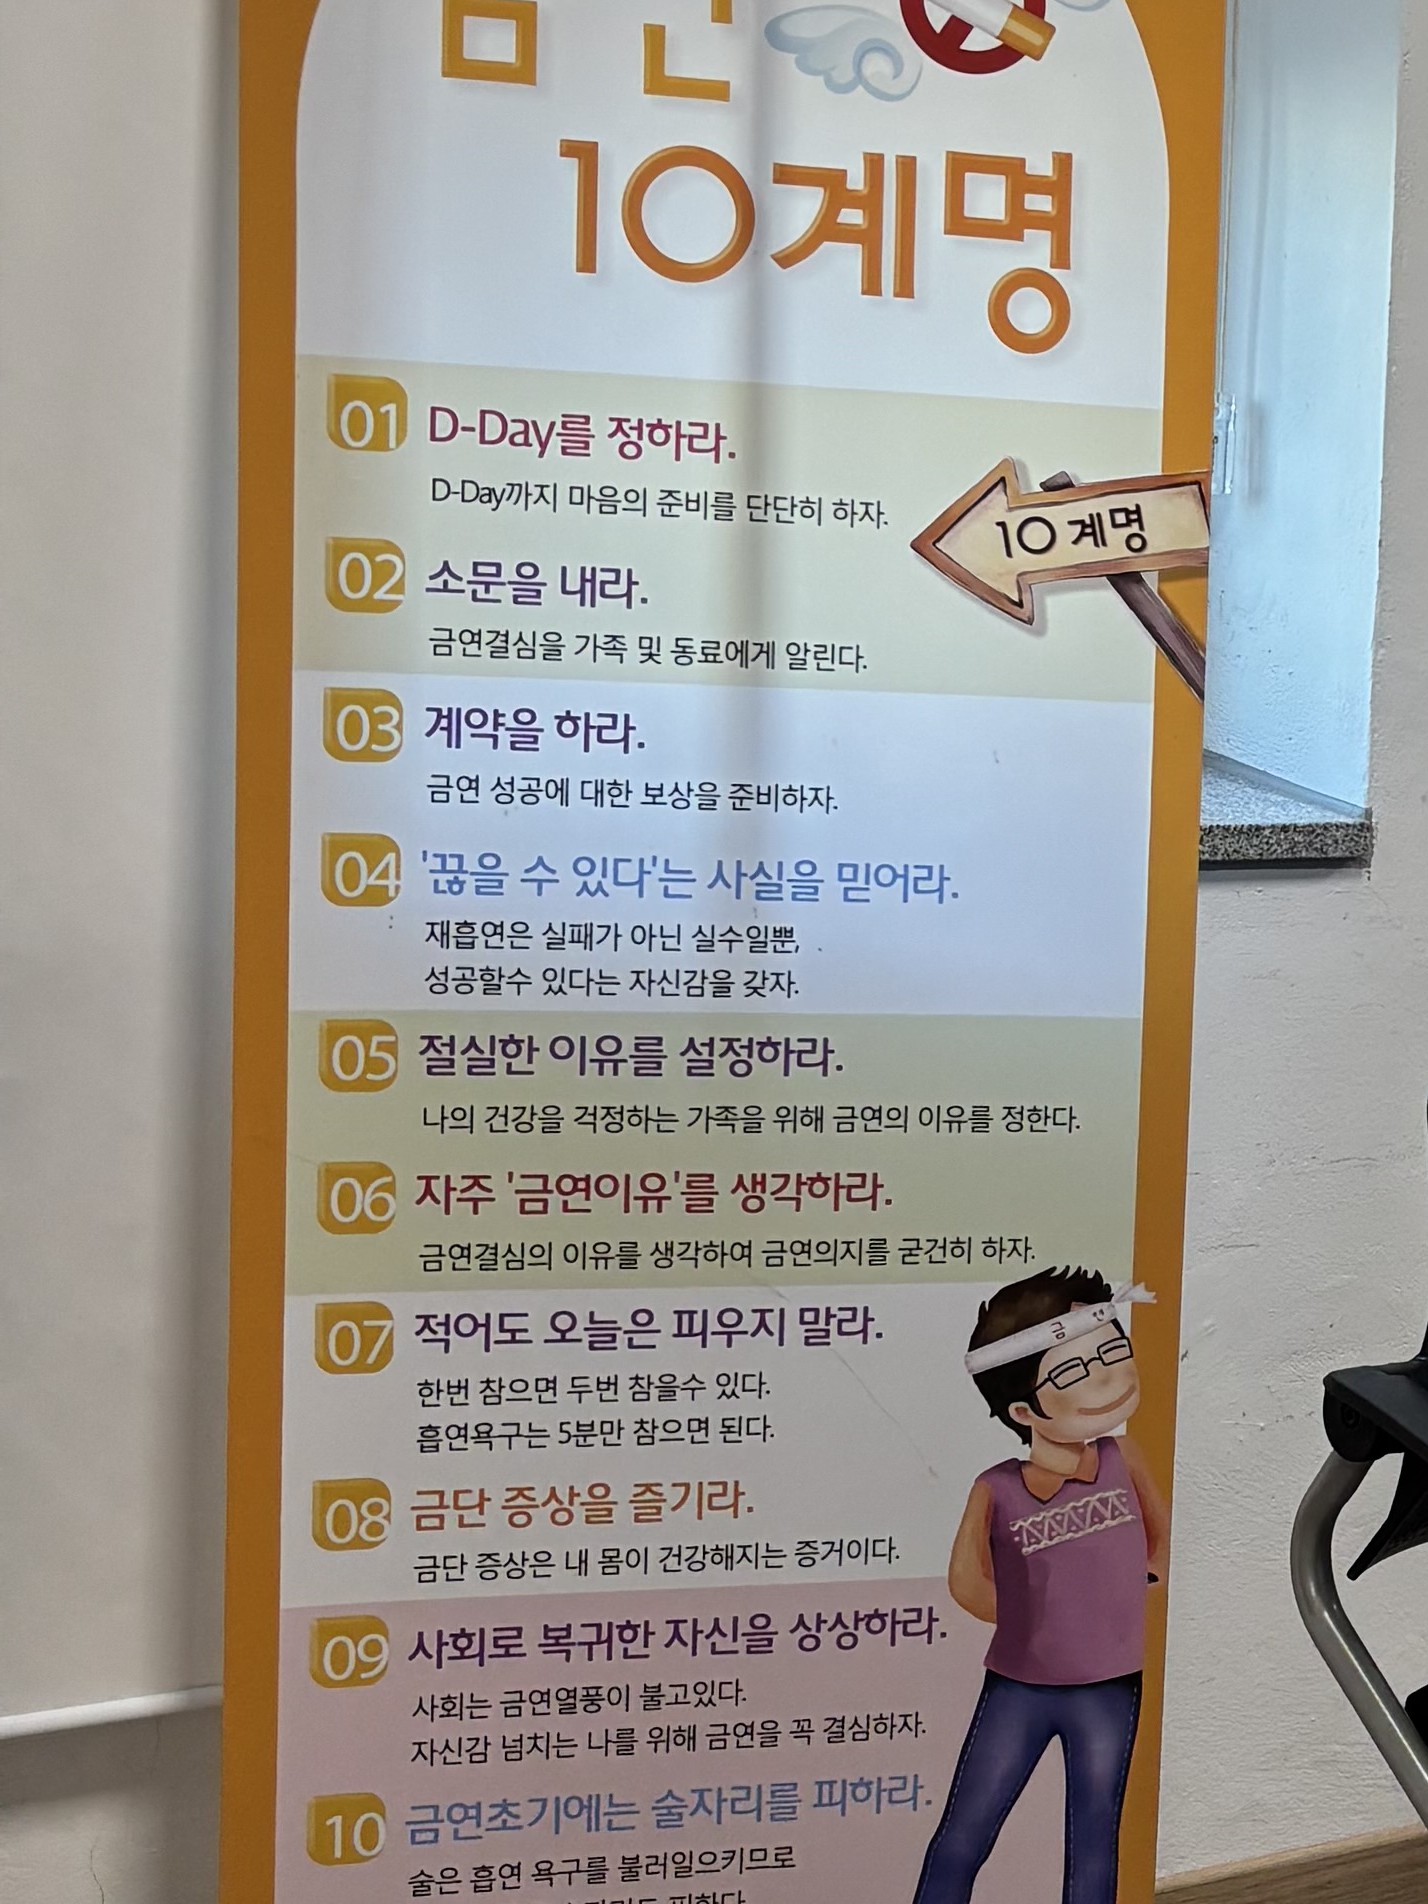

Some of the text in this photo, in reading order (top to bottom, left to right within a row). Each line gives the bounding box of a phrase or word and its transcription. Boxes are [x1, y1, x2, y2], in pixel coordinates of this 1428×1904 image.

[558, 137, 1074, 355] 10계명
[340, 400, 736, 464] 01 D-Day를 정하라.
[431, 477, 889, 530] D-Day까지 마음의 준비를 단단히 하자.
[338, 552, 648, 610] 02 소문을 내라.
[428, 627, 868, 674] 금연결심을 가족 및 동료에게 알린다.
[335, 703, 647, 755] 03 계약을 하라.
[426, 774, 839, 815] 금연 성공에 대한 보상을 준비하자.
[333, 850, 960, 905] 04 '끊을 수 있다'는 사실을 믿어라.
[424, 920, 801, 955] 재흡연은 실패가 아닌 실수일뿐,
[542, 968, 622, 997] 있다는
[629, 969, 736, 998] 자신감을
[743, 969, 800, 1000] 갖자.
[331, 1033, 845, 1082] 05 절실한 이유를 설정하라.
[422, 1104, 1082, 1135] 나의 건강을 걱정하는 가족을 위해 금연의 이유를 정한다.
[330, 1171, 894, 1224] 06 자주 '금연이유'를 생각하라.
[418, 1236, 1037, 1273] 금연결심의 이유를 생각하여 금연의지를 굳건히 하자.
[327, 1304, 884, 1366] 07 적어도 오늘은 피우지 말라.
[416, 1377, 470, 1408] 한번
[478, 1375, 559, 1407] 참으면
[567, 1373, 620, 1405] 두번
[715, 1370, 771, 1401] 있다.
[416, 1415, 776, 1455] 흡연욕구는 5분만 참으면 된다.
[324, 1479, 755, 1545] 08 금단 증상을 즐기라.
[413, 1536, 901, 1584] 금단 증상은 내 몸이 건강해지는 증거이다.
[321, 1605, 948, 1682] 09 사회로 복귀한 자신을 상상하라.
[411, 1677, 747, 1723] 사회는 금연열풍이 불고있다.
[410, 1711, 927, 1768] 자신감 넘치는 나를 위해 금연을 꼭 결심하자.
[325, 1774, 933, 1860] 10 금연초기에는 술자리를 피하라.
[408, 1846, 797, 1899] 술은 흡연 욕구를 불러일으키므로
